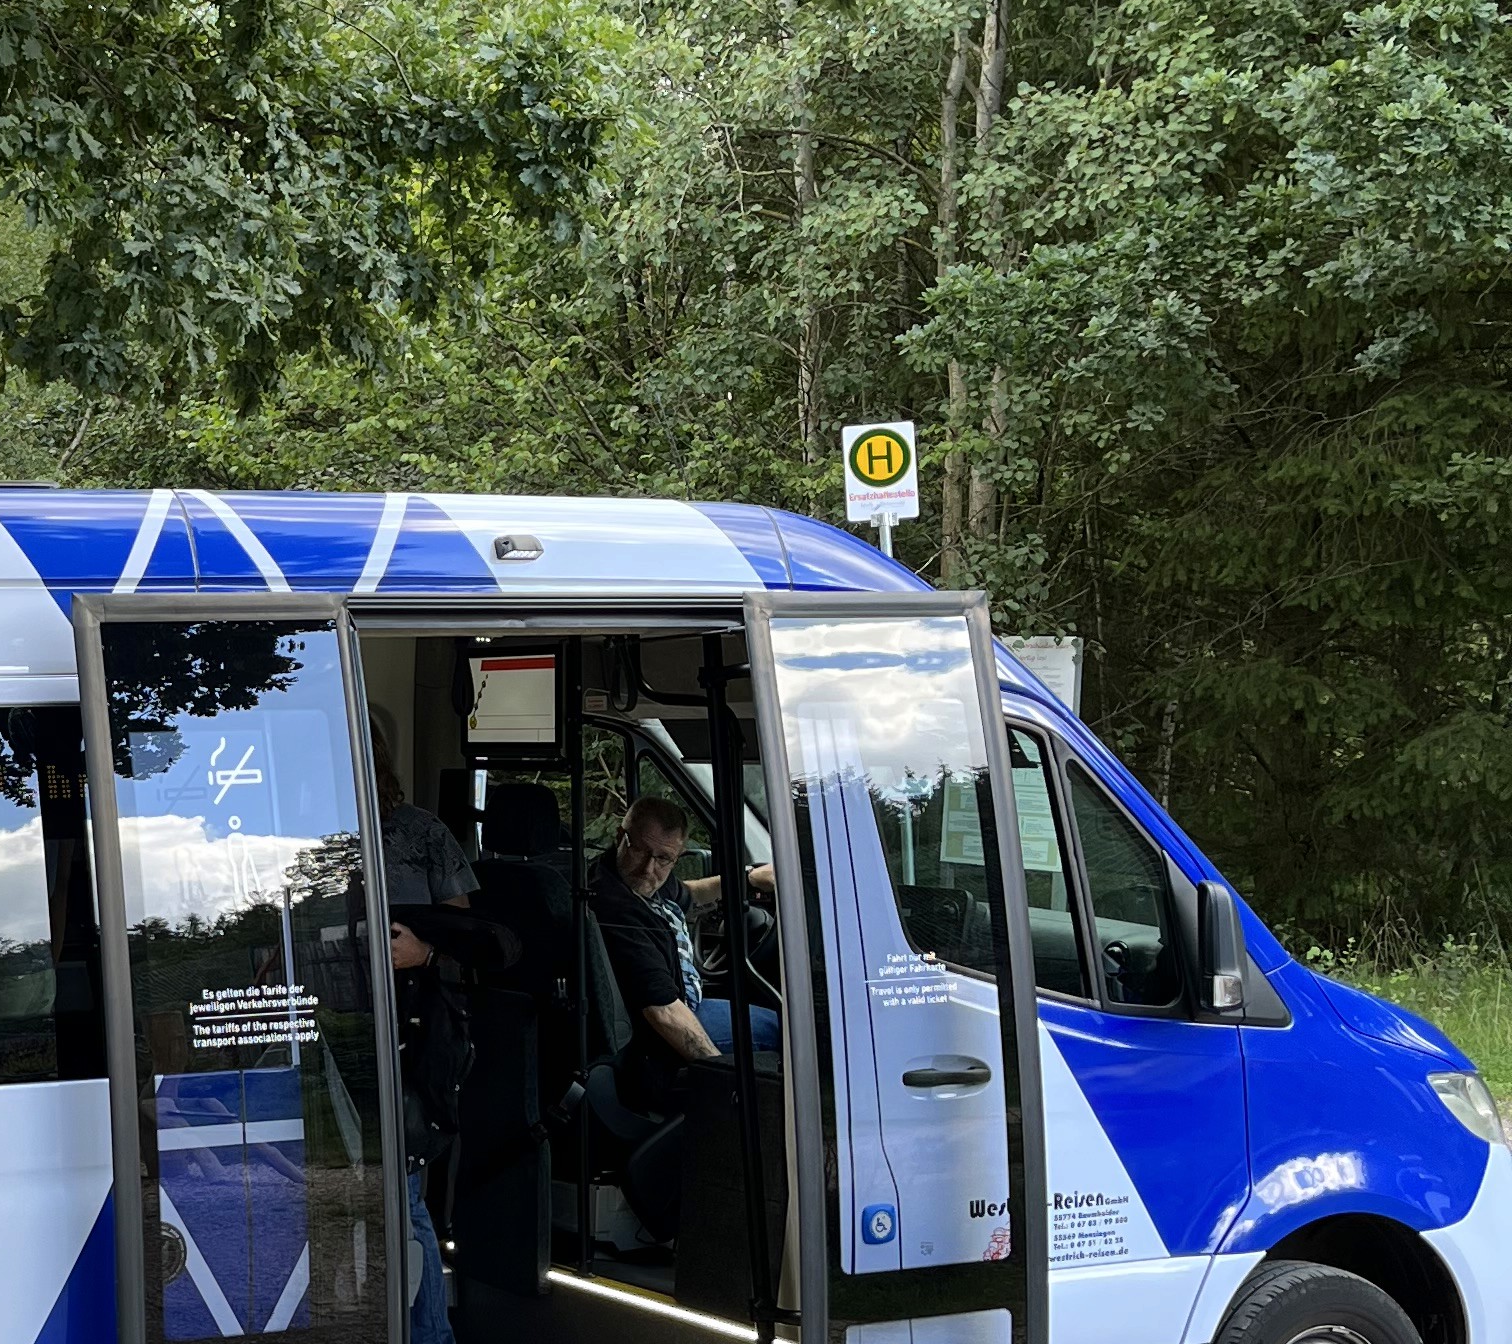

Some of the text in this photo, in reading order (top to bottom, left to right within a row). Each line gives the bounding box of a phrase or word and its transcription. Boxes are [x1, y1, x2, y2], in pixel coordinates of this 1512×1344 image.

[866, 440, 894, 475] H
[886, 953, 908, 963] Fahrt
[909, 953, 922, 962] nur
[909, 962, 947, 973] Fahrkarte
[202, 983, 305, 1001] Es gelten die Tarife der
[870, 982, 958, 996] Travel is only permitted
[189, 994, 319, 1015] jeweiligen Verkehrsverbünde
[882, 993, 948, 1007] with a valid ticket
[192, 1017, 316, 1036] The tariffs of the respective
[193, 1029, 320, 1048] transport associations apply
[1104, 1195, 1130, 1205] GmbH
